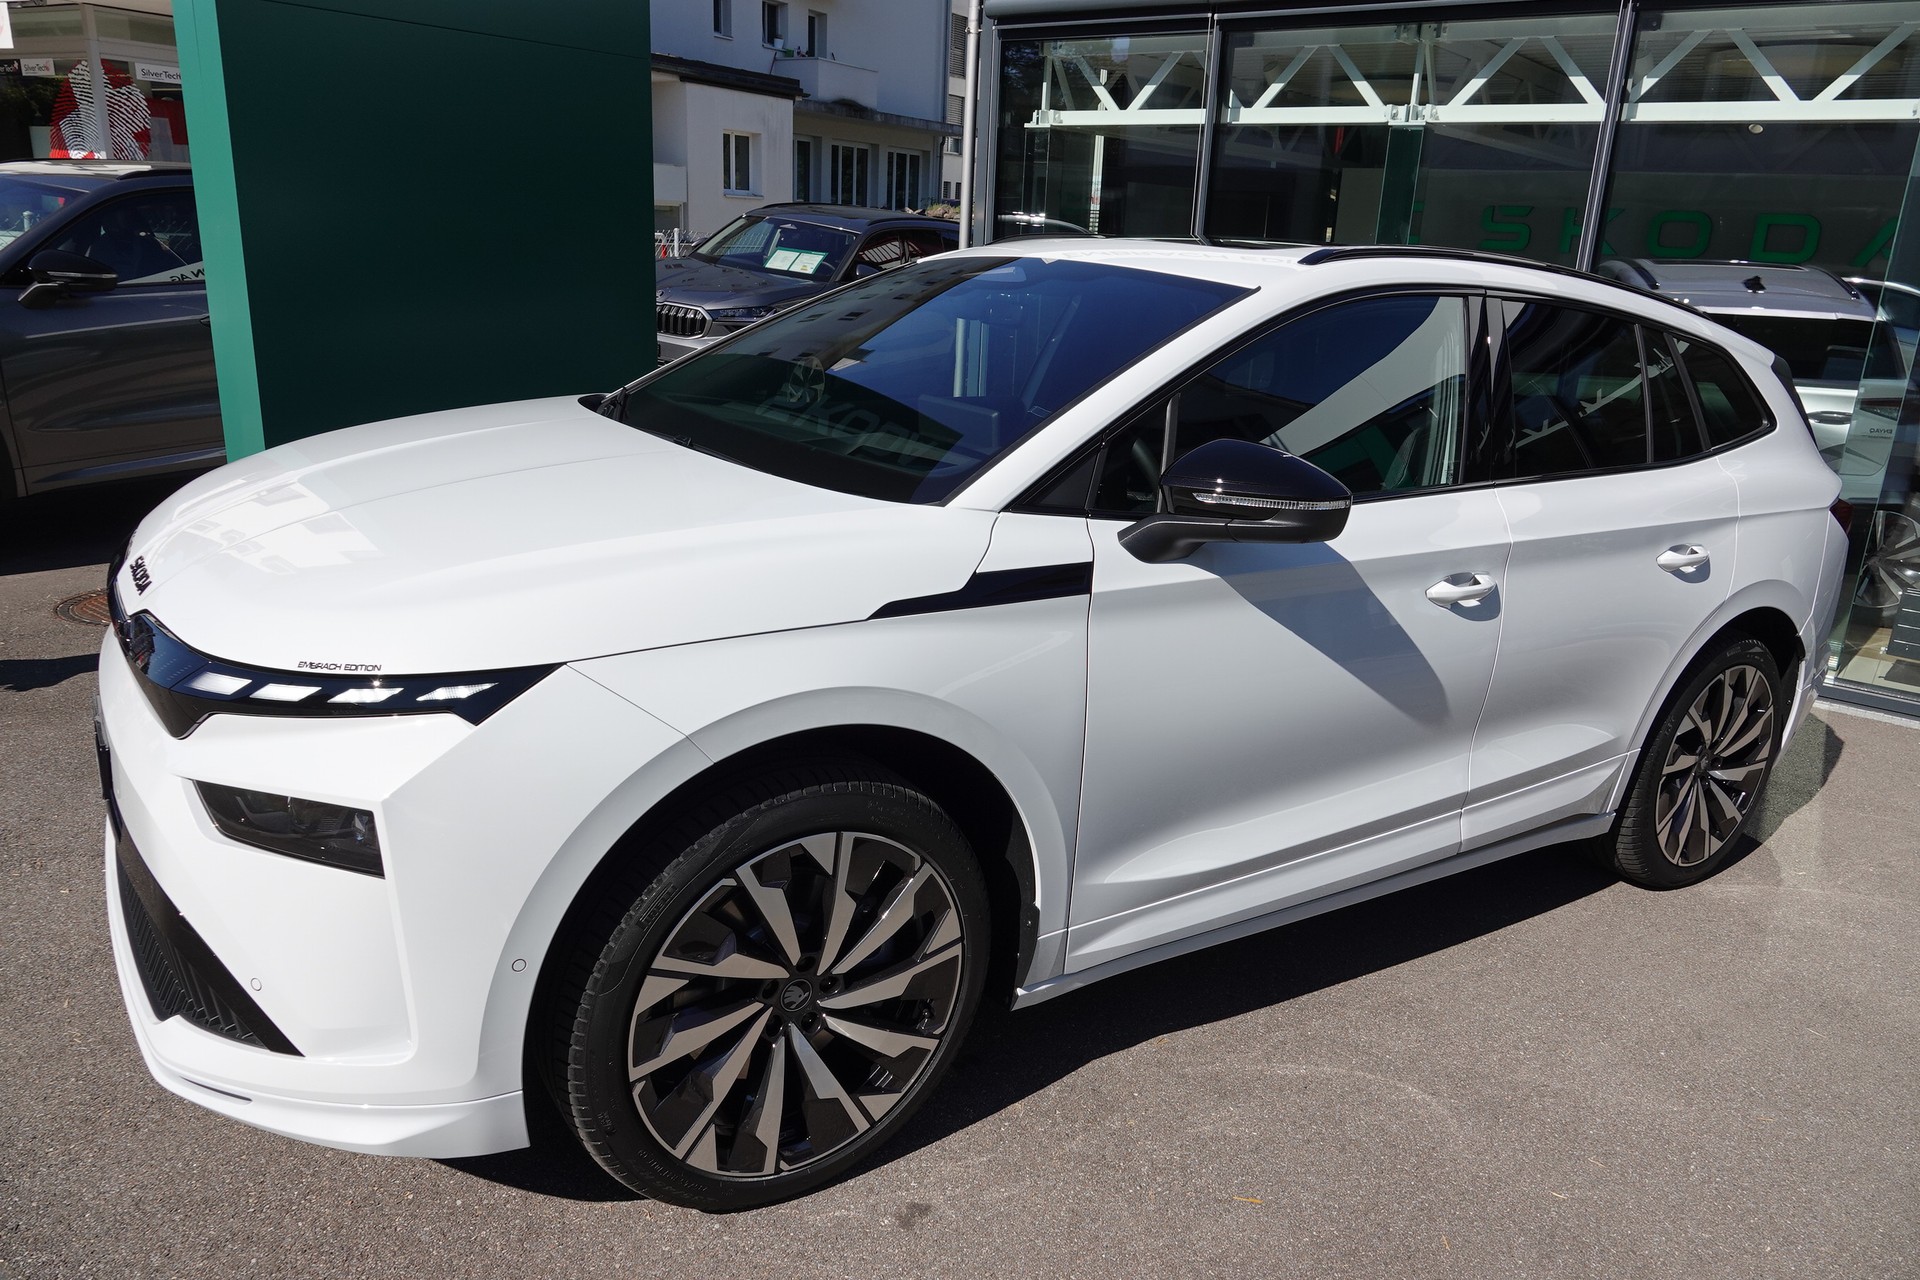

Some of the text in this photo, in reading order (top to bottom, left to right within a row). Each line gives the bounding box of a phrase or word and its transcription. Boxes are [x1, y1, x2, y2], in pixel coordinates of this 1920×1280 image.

[141, 68, 181, 80] SilverTech
[297, 660, 382, 672] EMBRACH EDITION
